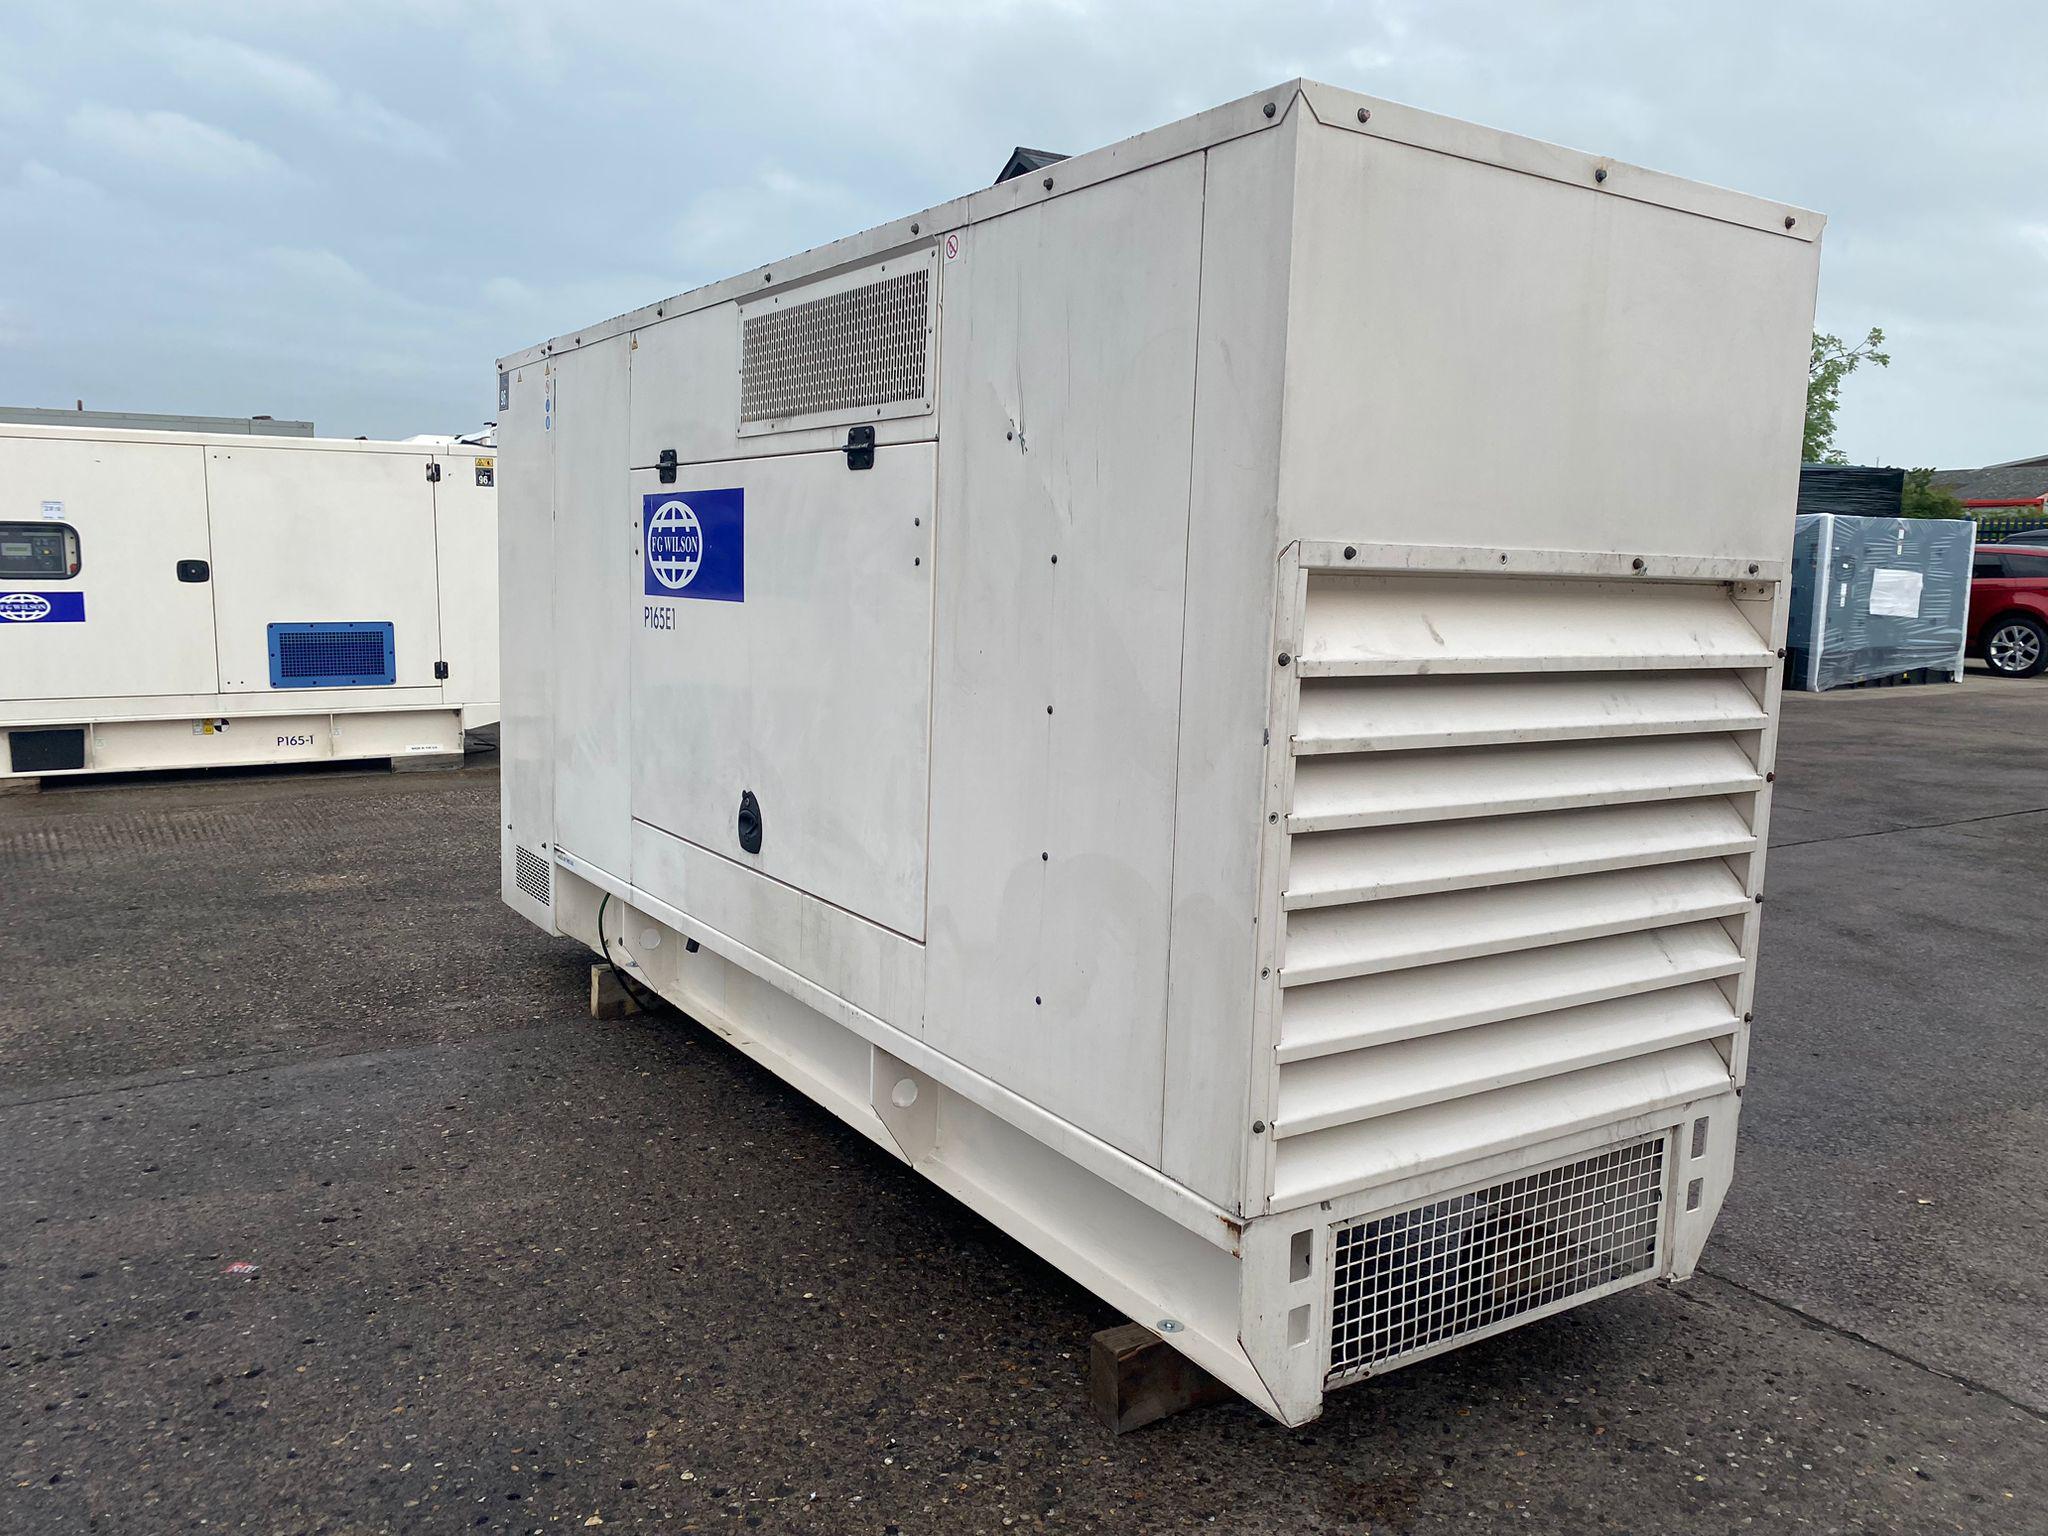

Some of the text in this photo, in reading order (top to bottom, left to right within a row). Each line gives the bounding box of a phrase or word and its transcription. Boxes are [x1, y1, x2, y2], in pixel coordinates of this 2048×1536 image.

[652, 536, 698, 553] FG WILSON
[13, 603, 47, 611] WILSON
[644, 606, 676, 630] P165E1
[277, 735, 314, 746] P165-1
